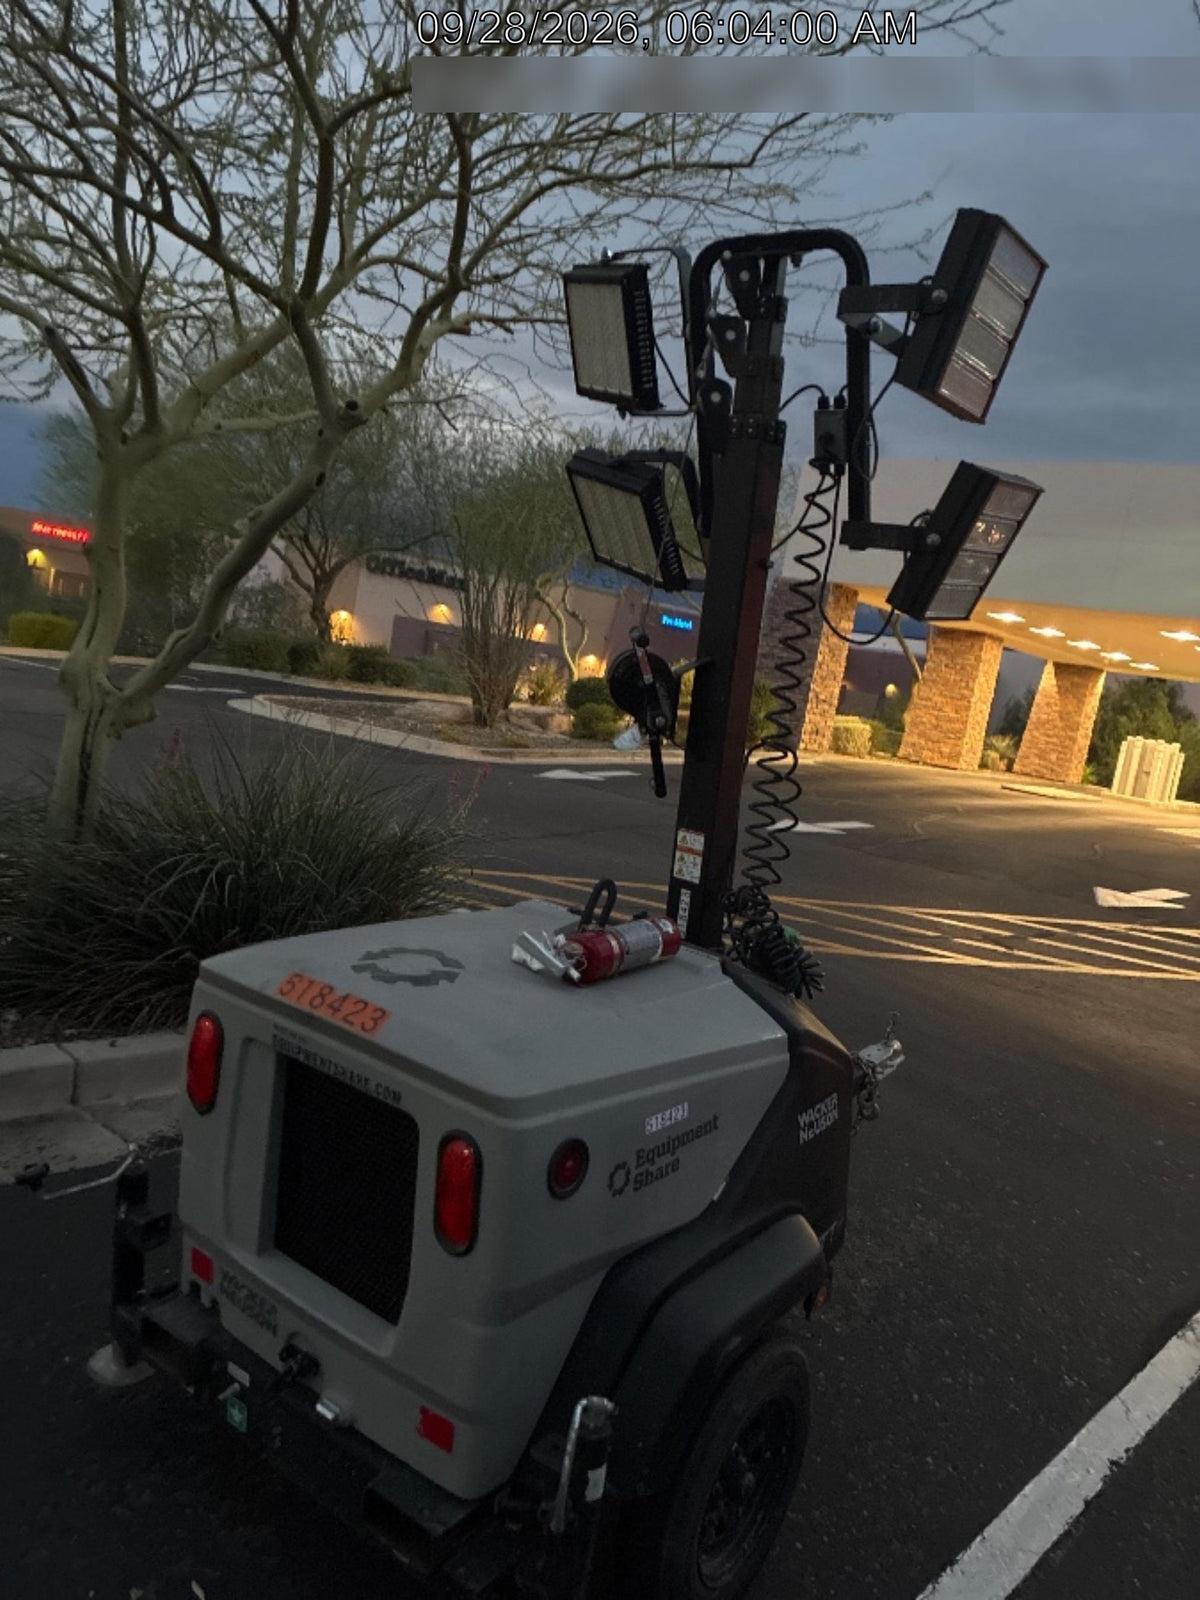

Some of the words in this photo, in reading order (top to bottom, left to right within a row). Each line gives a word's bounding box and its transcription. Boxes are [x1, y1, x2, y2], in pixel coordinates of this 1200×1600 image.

[279, 972, 387, 1033] 518423
[798, 1092, 838, 1128] WACKER
[634, 1114, 720, 1170] Equipment
[632, 1157, 680, 1193] Share
